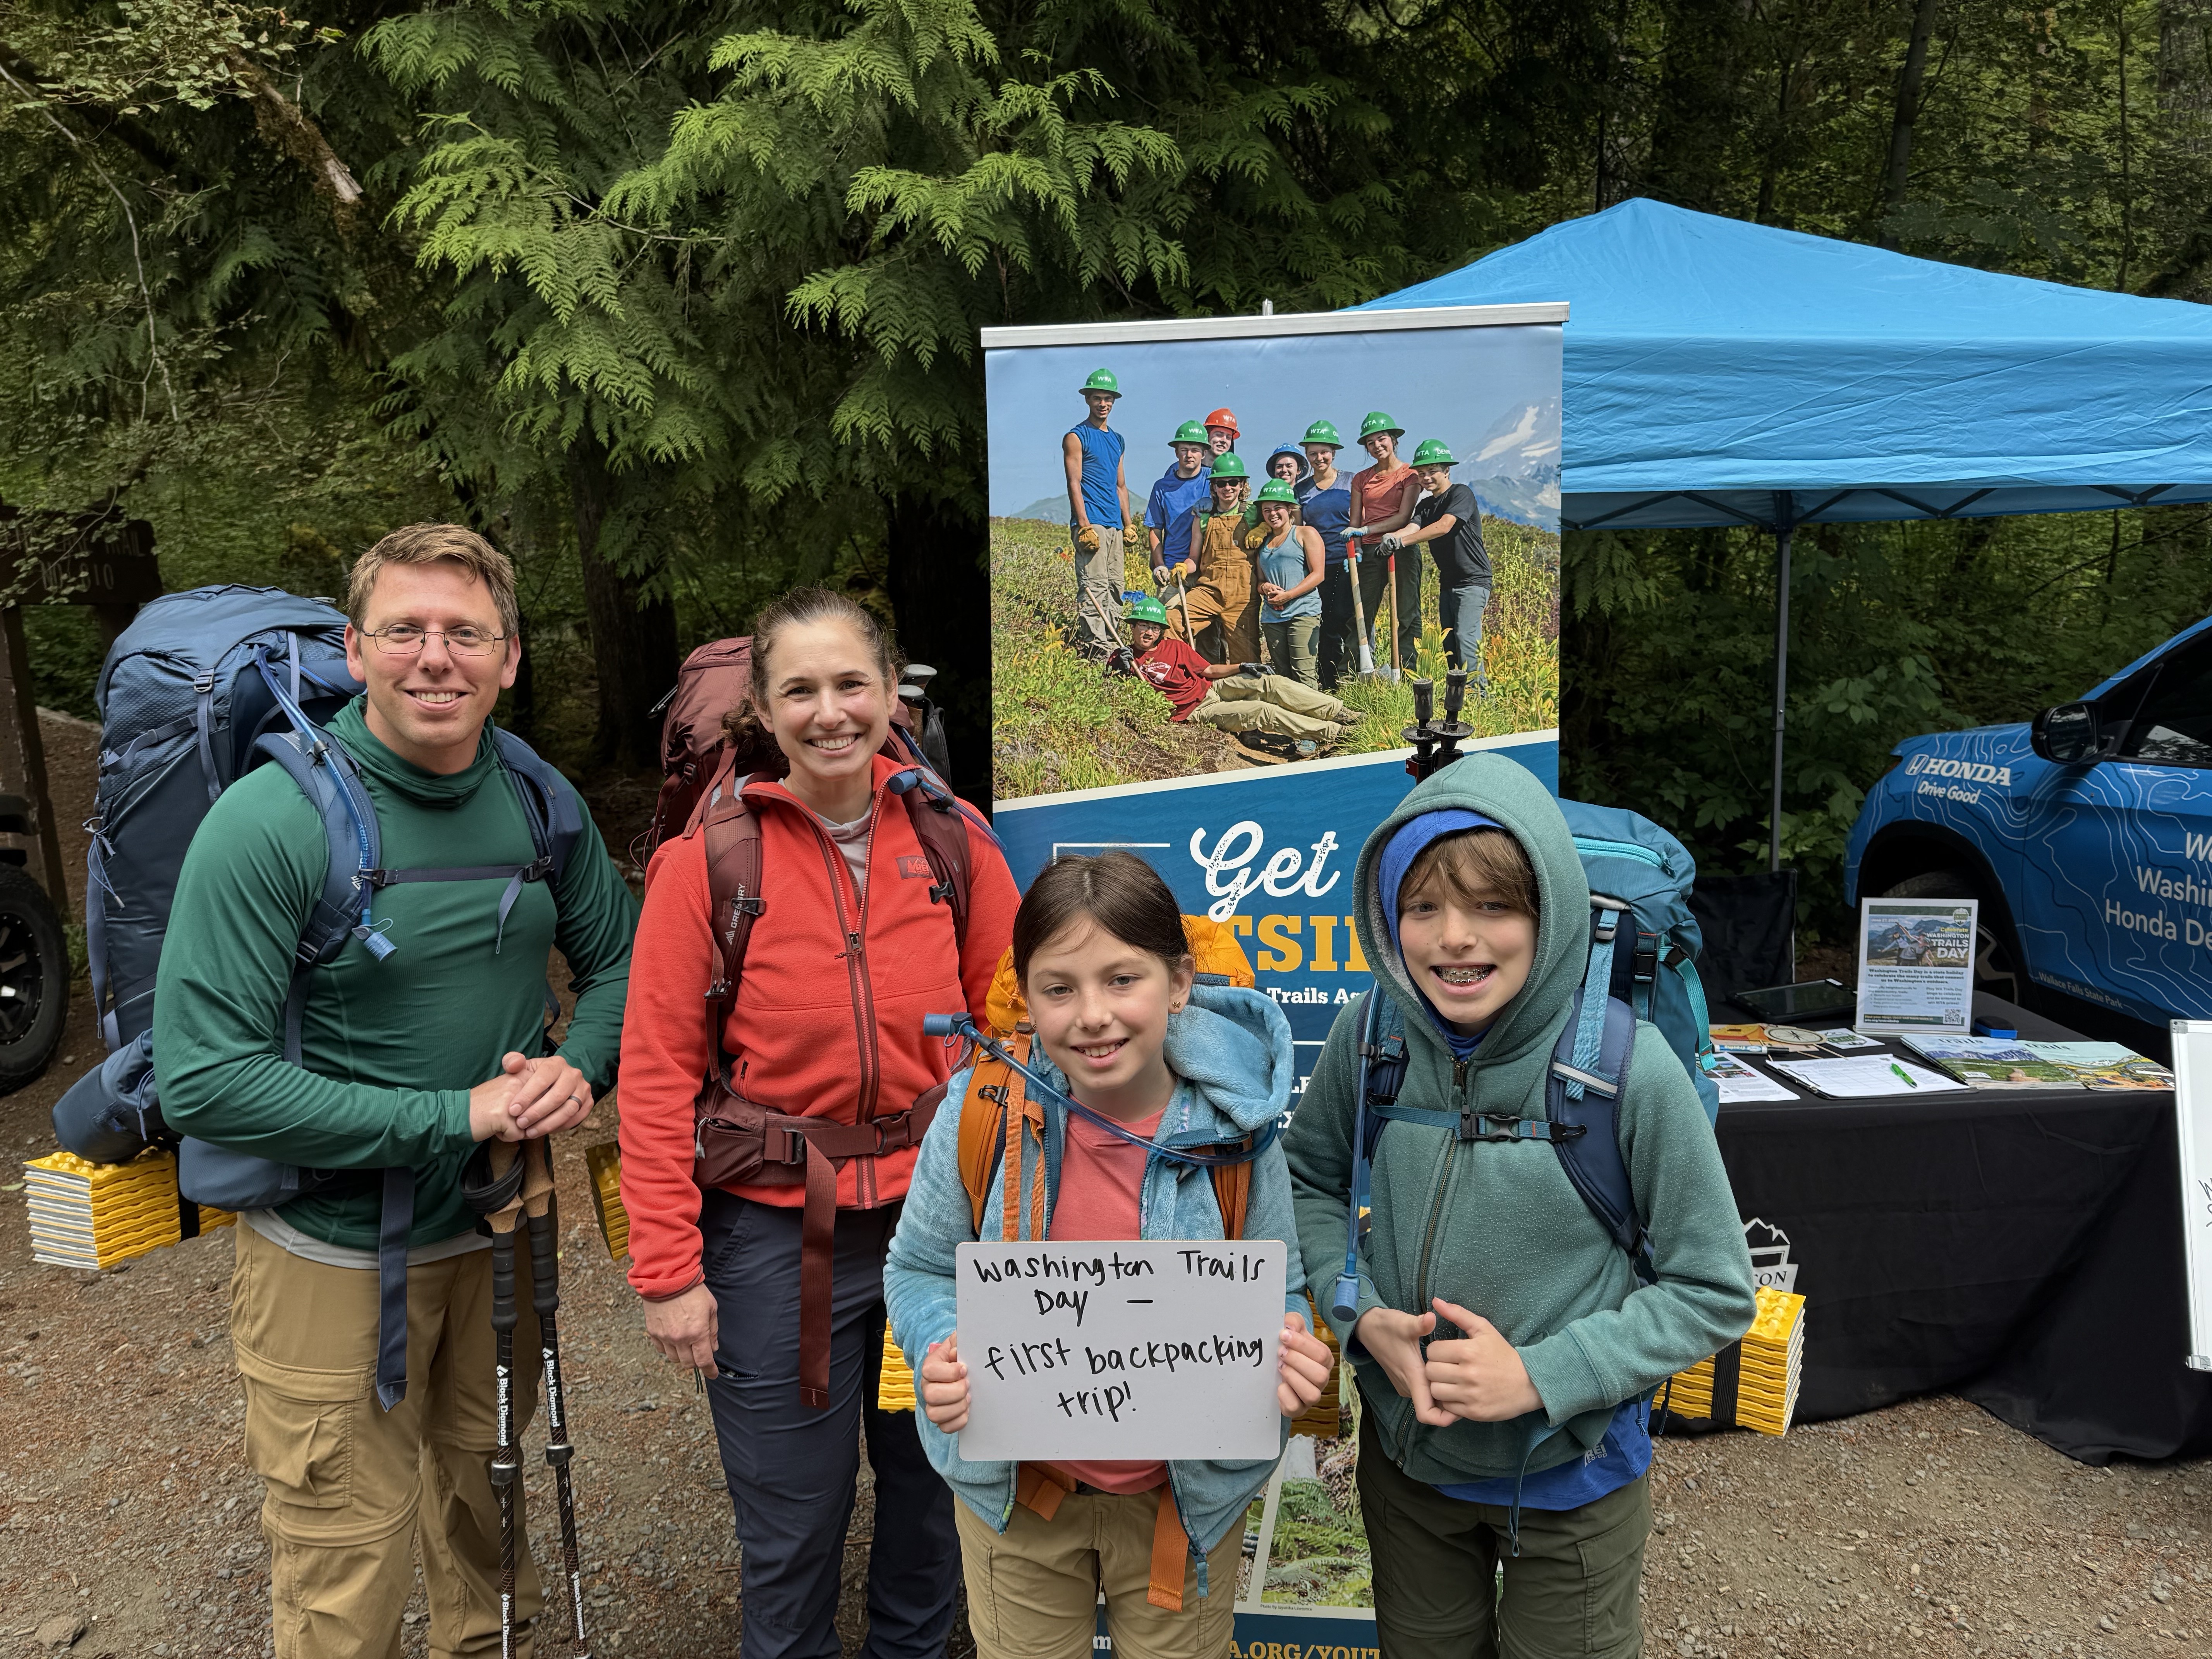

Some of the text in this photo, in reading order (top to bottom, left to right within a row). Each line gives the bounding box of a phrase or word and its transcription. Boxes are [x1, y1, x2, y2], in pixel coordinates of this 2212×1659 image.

[1223, 415, 1235, 423] WTA
[1363, 419, 1377, 428] WTA
[1922, 758, 2011, 787] HONDA
[1917, 780, 1982, 804] Drive Good
[1189, 820, 1341, 922] Get
[2106, 898, 2177, 941] Honda
[1932, 939, 1969, 947] TRAILS
[1937, 948, 1968, 958] DAY
[1266, 987, 1328, 1004] Trails
[2038, 971, 2123, 1009] Wallace Falls State Park
[1176, 1250, 1266, 1283] Trails
[1754, 1271, 1788, 1286] ON
[1034, 1289, 1089, 1328] Day
[984, 1334, 1263, 1381] first backpacking
[546, 1360, 560, 1427] Black Diamond
[1057, 1381, 1137, 1423] trip!
[500, 1378, 509, 1446] Black Diamond
[1586, 1444, 1607, 1460] REI
[576, 1601, 586, 1640] Diamond
